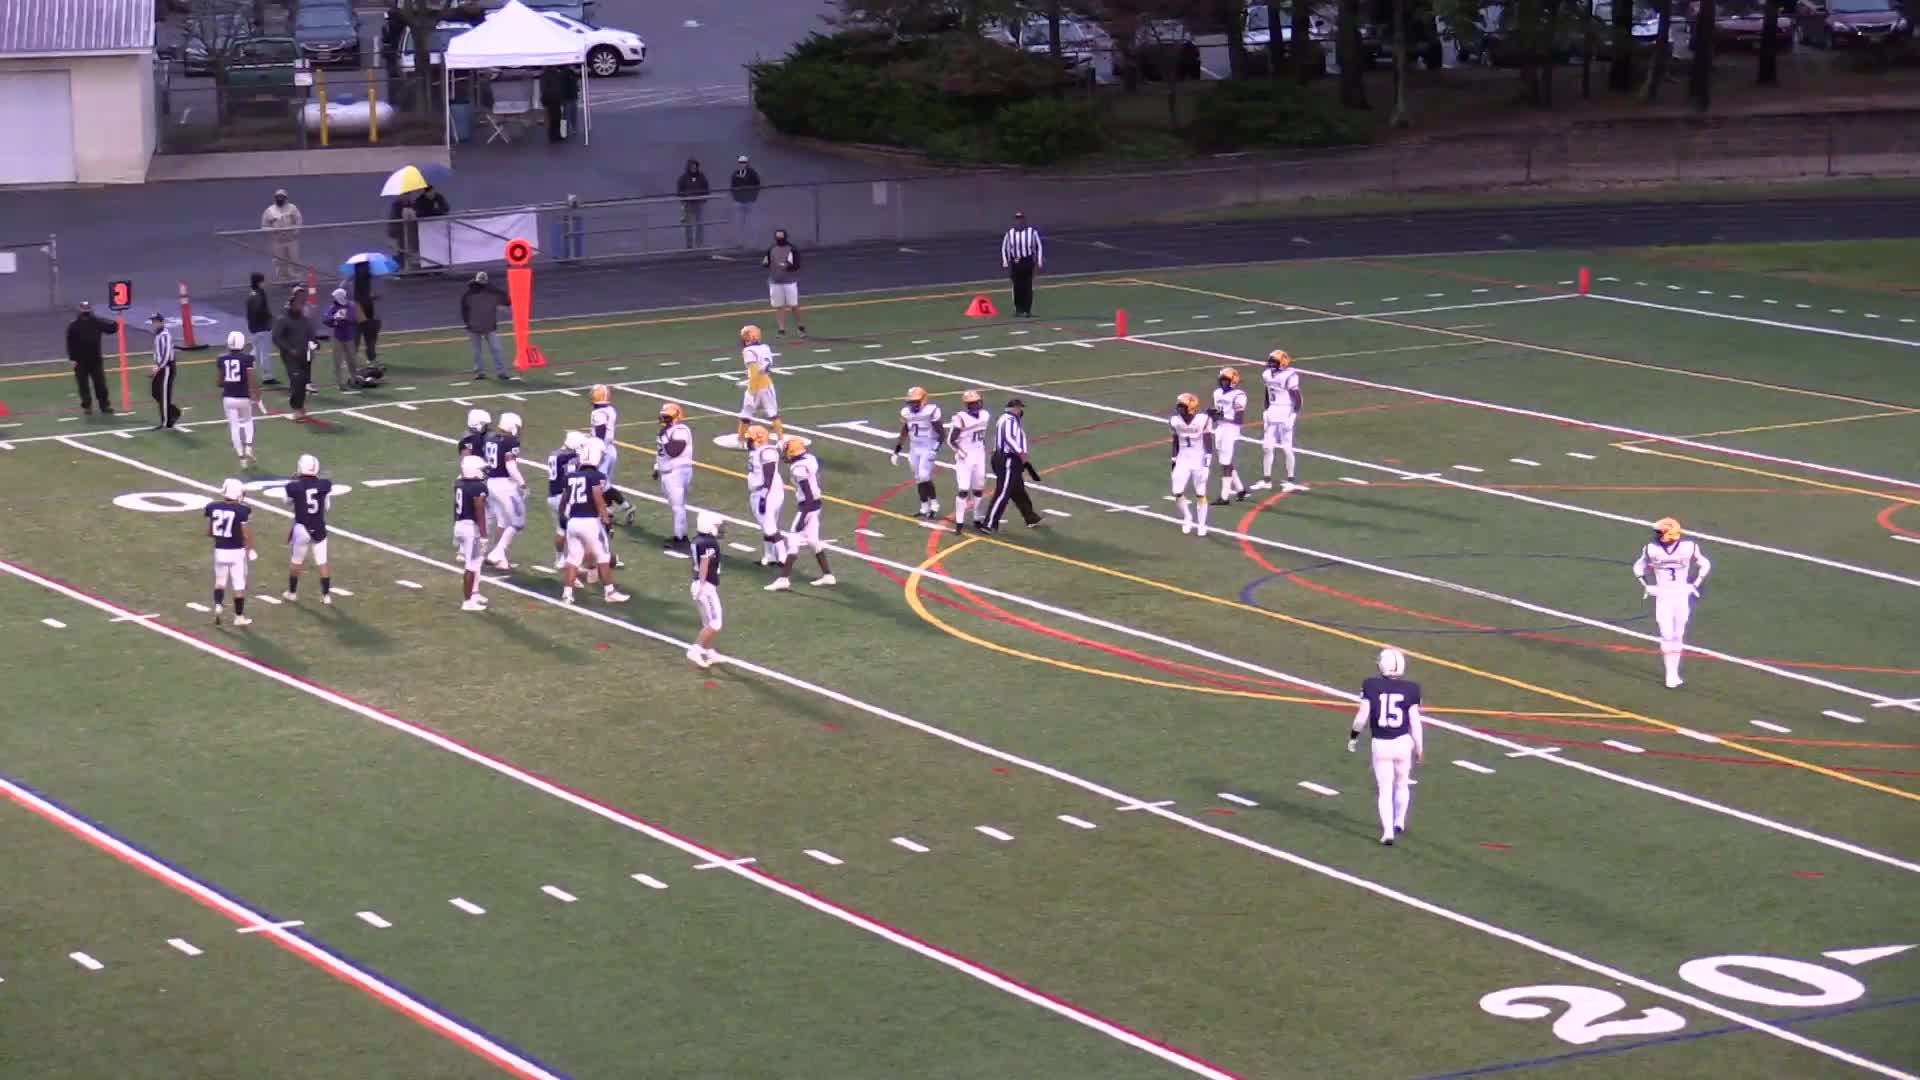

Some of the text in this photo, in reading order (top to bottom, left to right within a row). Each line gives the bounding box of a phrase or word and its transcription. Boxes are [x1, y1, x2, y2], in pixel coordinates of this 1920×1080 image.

[113, 282, 128, 305] 3
[979, 299, 992, 315] G
[223, 359, 241, 382] 12
[305, 488, 320, 514] 5
[567, 477, 588, 505] 72
[211, 509, 236, 538] 27
[1377, 693, 1405, 728] 15
